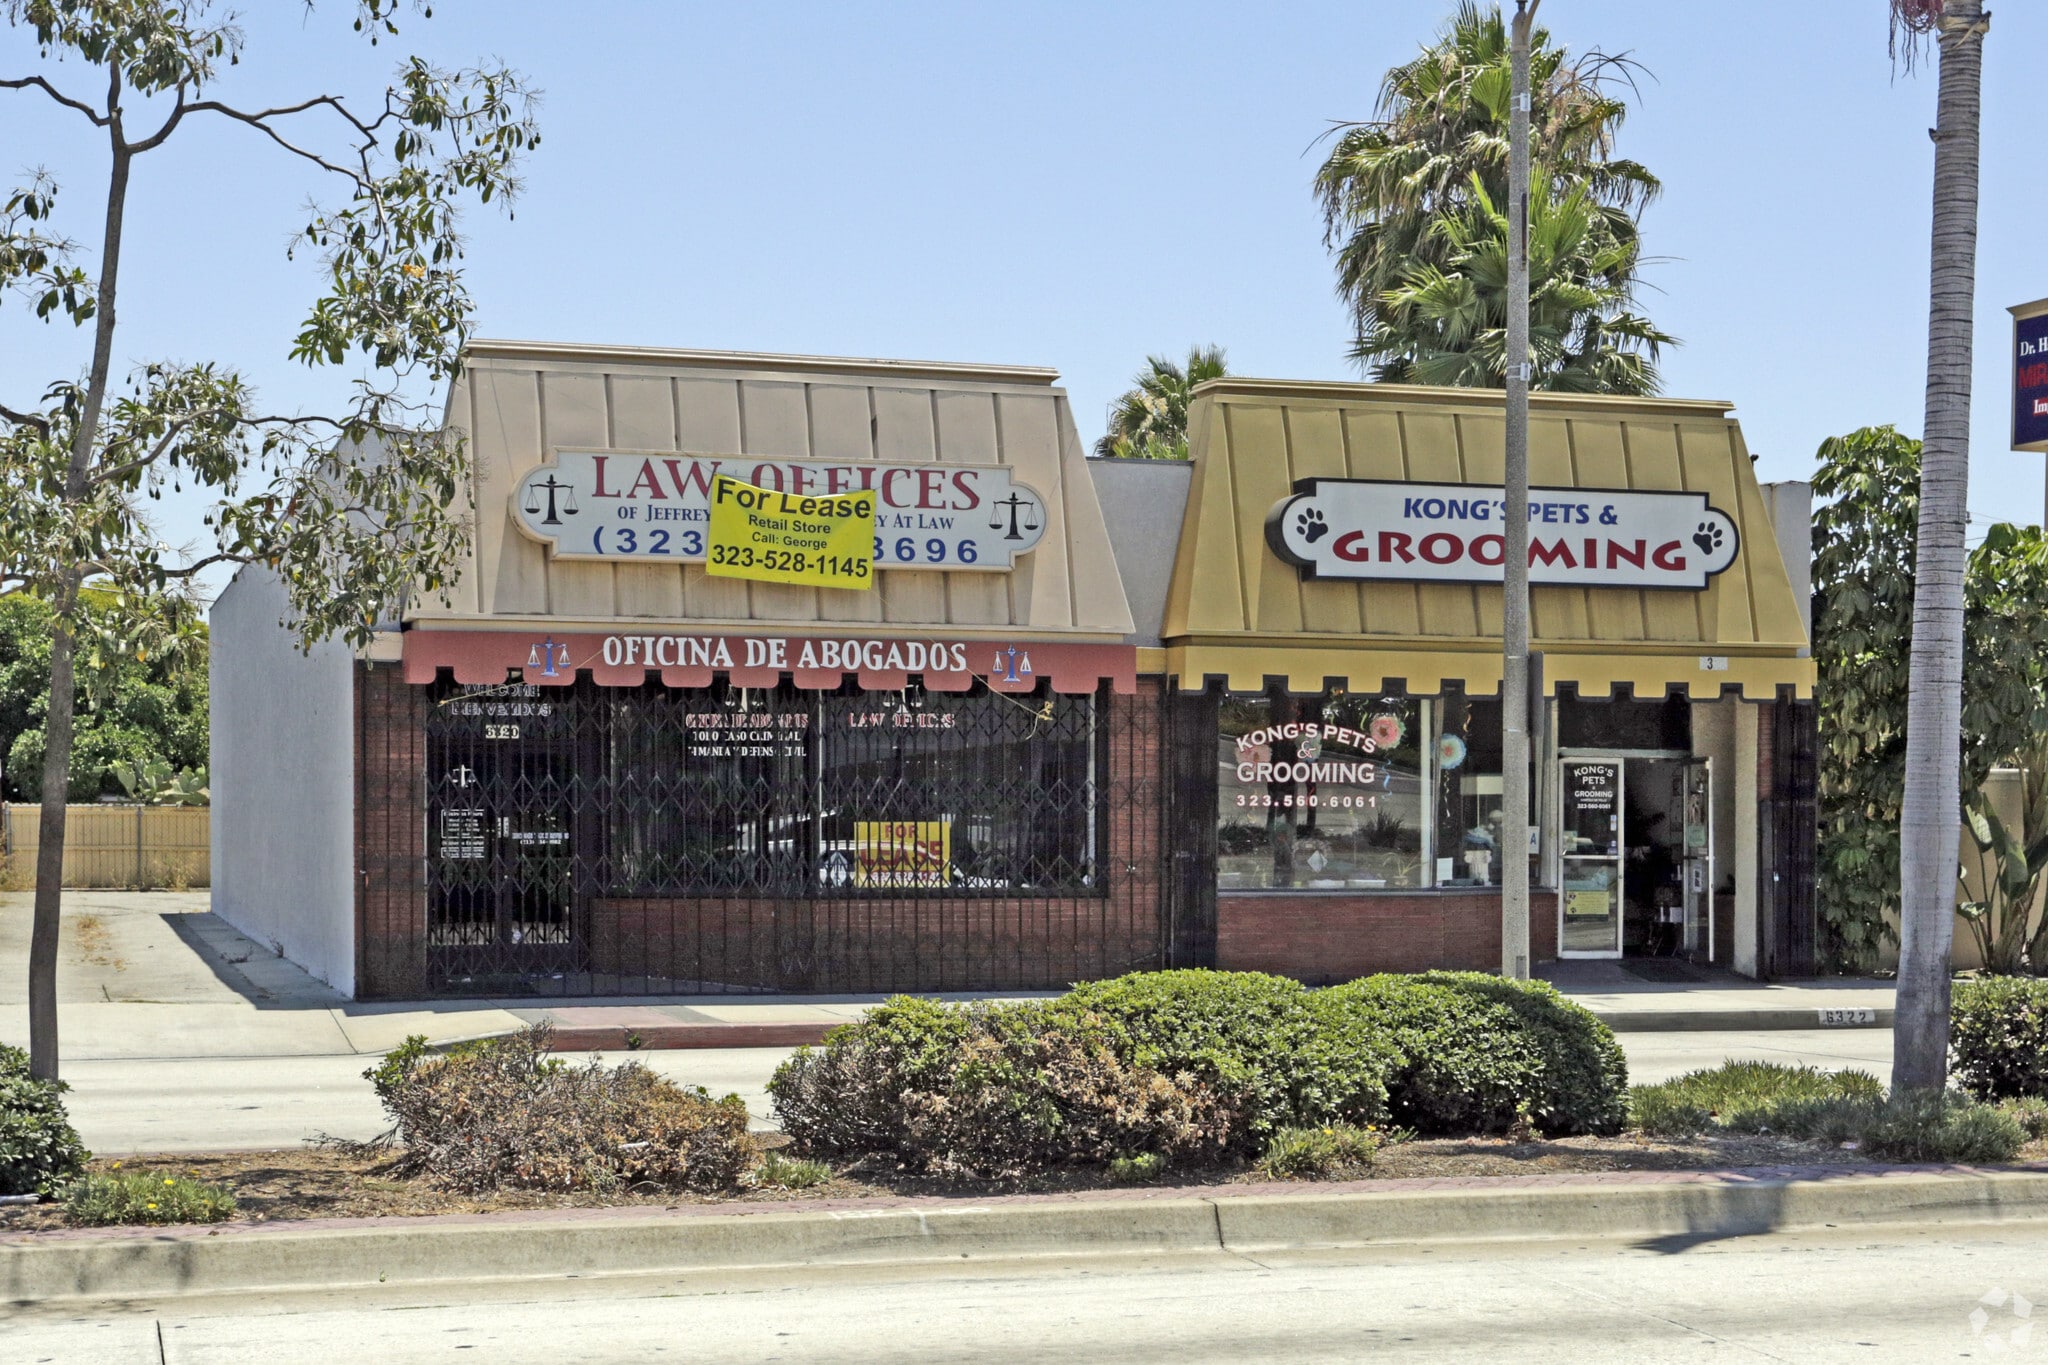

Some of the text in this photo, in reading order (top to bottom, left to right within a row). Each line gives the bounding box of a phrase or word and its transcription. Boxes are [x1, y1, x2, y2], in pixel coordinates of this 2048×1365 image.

[2020, 341, 2036, 356] Dr.
[592, 456, 980, 510] LAW OFFICES
[717, 478, 871, 518] For Lease
[645, 505, 711, 522] JEFFREY
[1527, 502, 1590, 524] PETS
[1598, 504, 1618, 525] &
[748, 514, 831, 534] Retail Store
[752, 531, 828, 550] Call: George
[1332, 529, 1686, 572] GROOMING
[712, 544, 868, 578] 323-528-1145
[602, 636, 967, 672] OFICINA DE ABOGADOS
[1235, 722, 1377, 754] KONG'S PETS
[1296, 740, 1316, 759] &
[1236, 762, 1375, 783] GROOMING
[1573, 766, 1614, 777] KONG'S
[1582, 776, 1606, 785] PETS
[1236, 795, 1376, 808] 323.560.6061
[1574, 790, 1613, 798] GROOMING
[1530, 833, 1537, 845] A
[860, 841, 944, 866] LEASE
